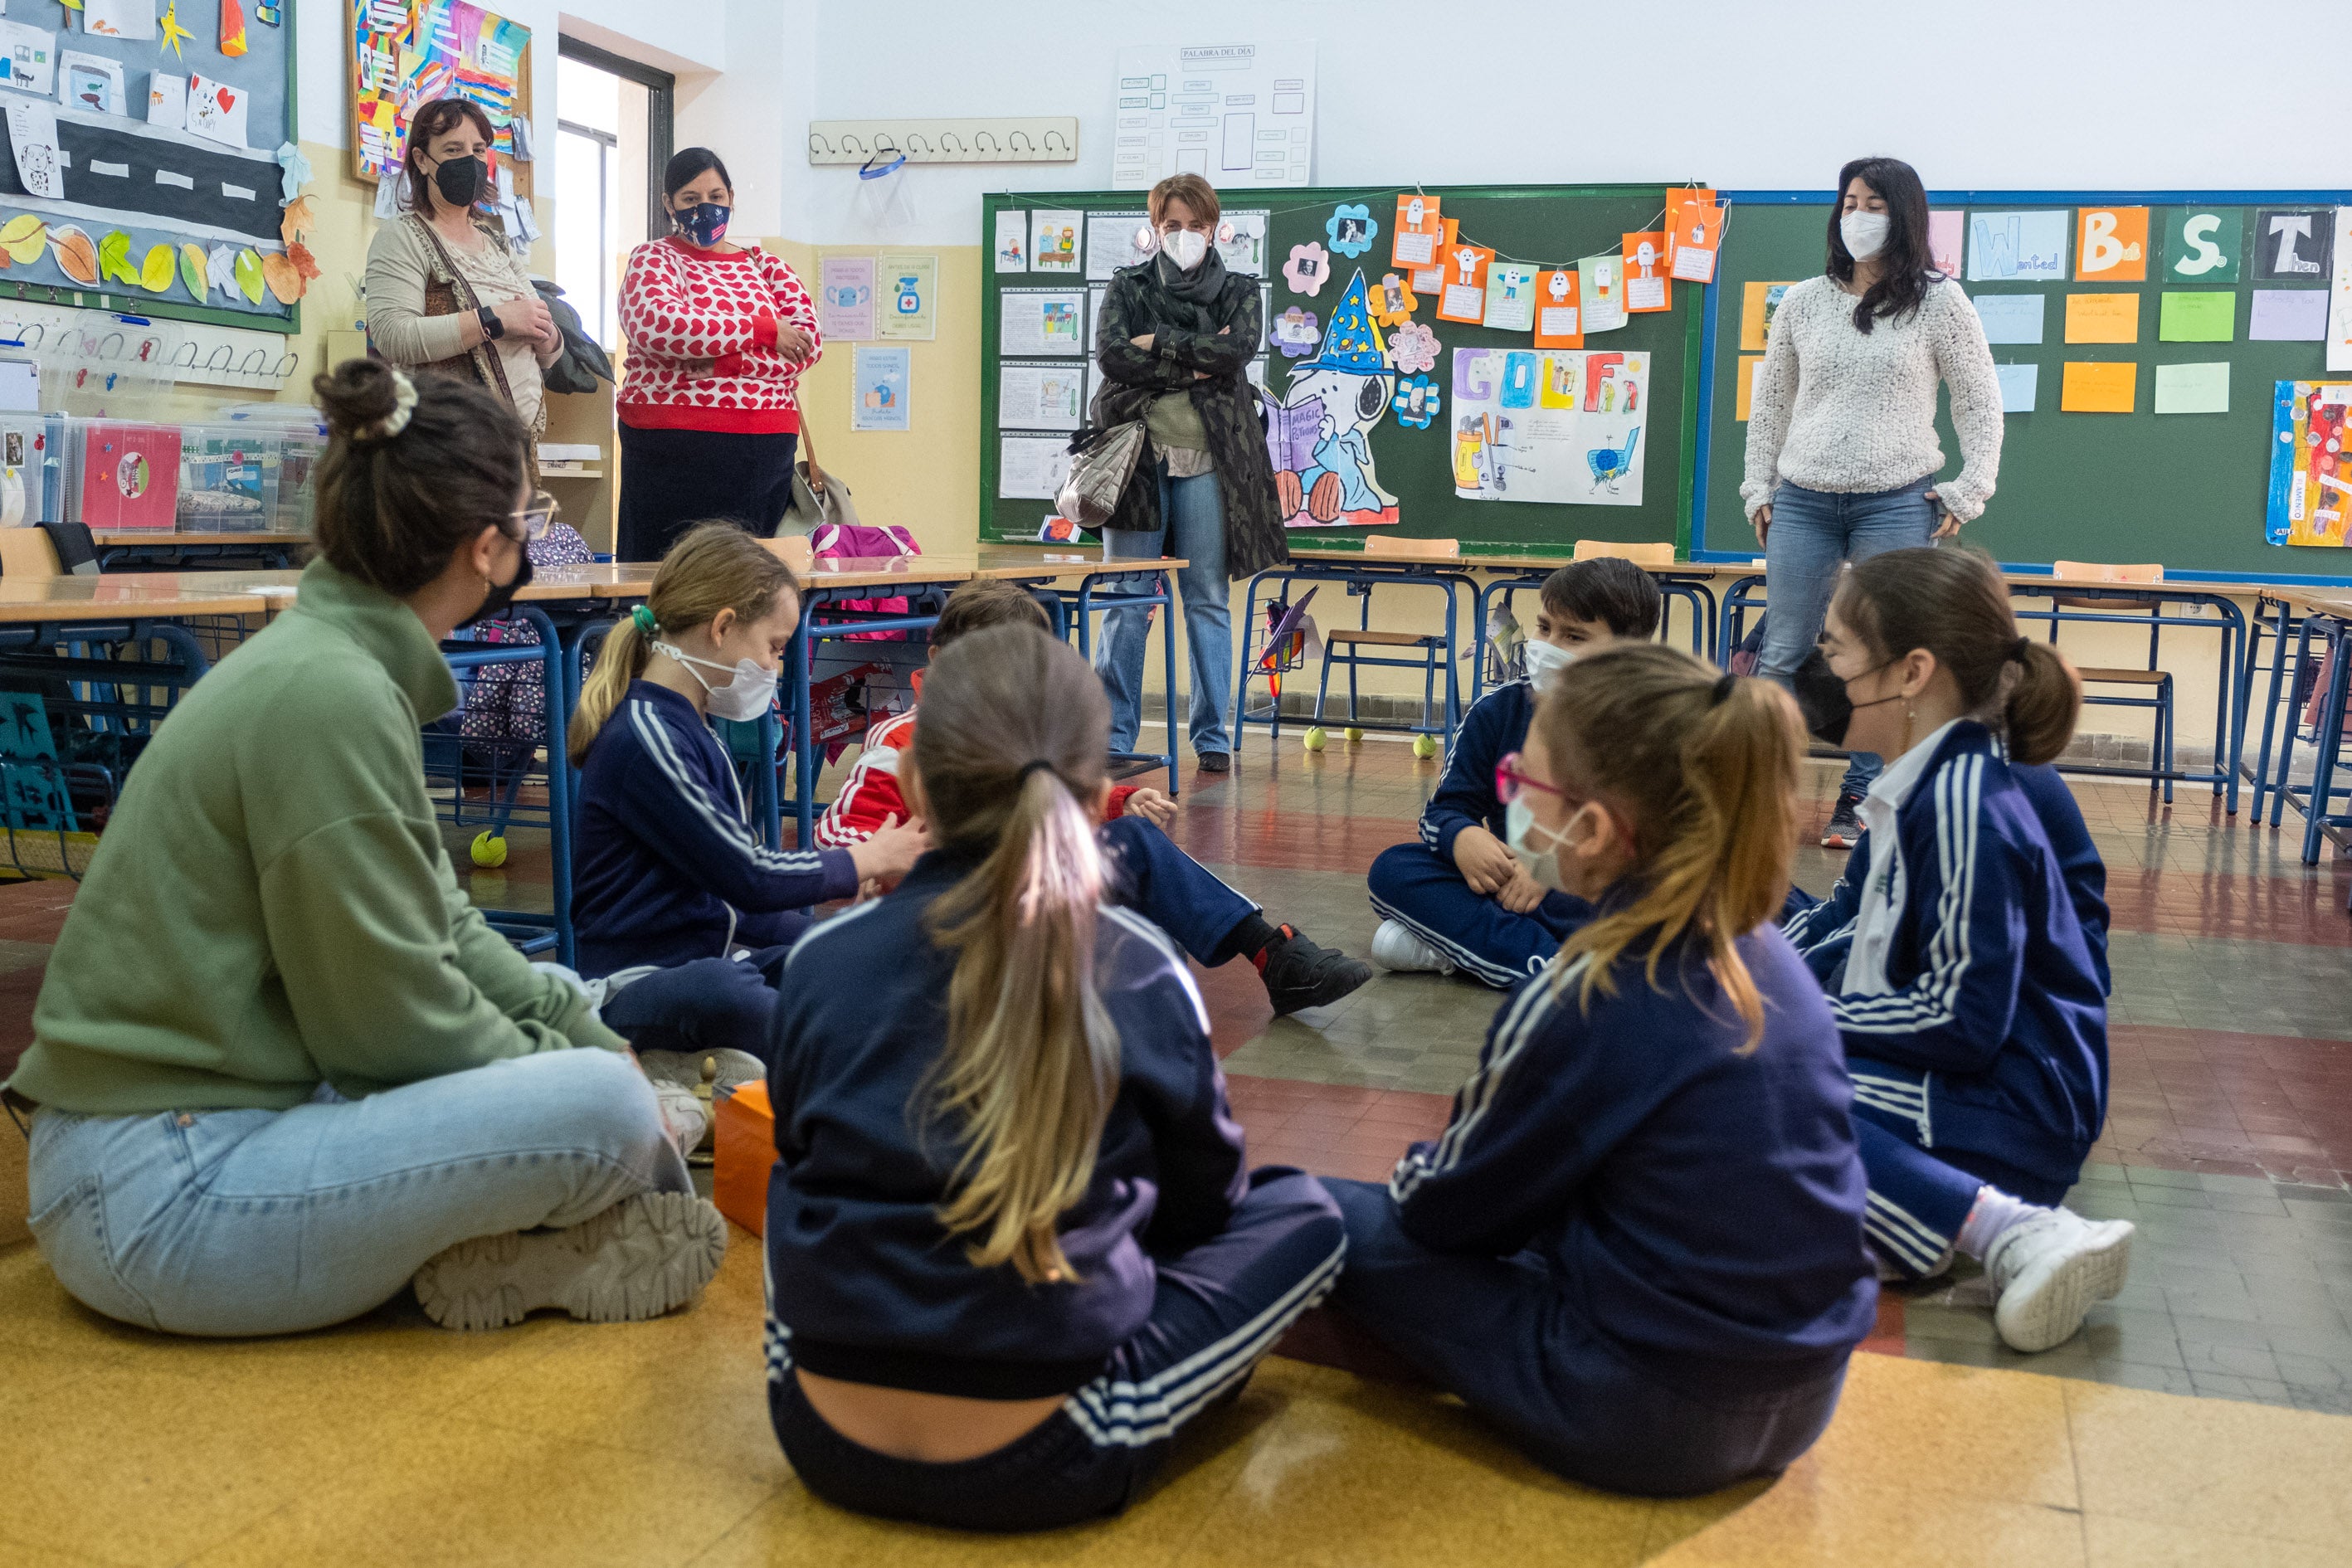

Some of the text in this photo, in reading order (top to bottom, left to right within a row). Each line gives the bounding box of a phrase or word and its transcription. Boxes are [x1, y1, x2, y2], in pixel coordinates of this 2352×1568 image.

[1974, 215, 2058, 277] Wanted
[2268, 215, 2320, 274] Then
[1453, 348, 1624, 412] GOLF
[1291, 408, 1321, 426] MAGIC
[2295, 479, 2303, 518] FLAMENCO
